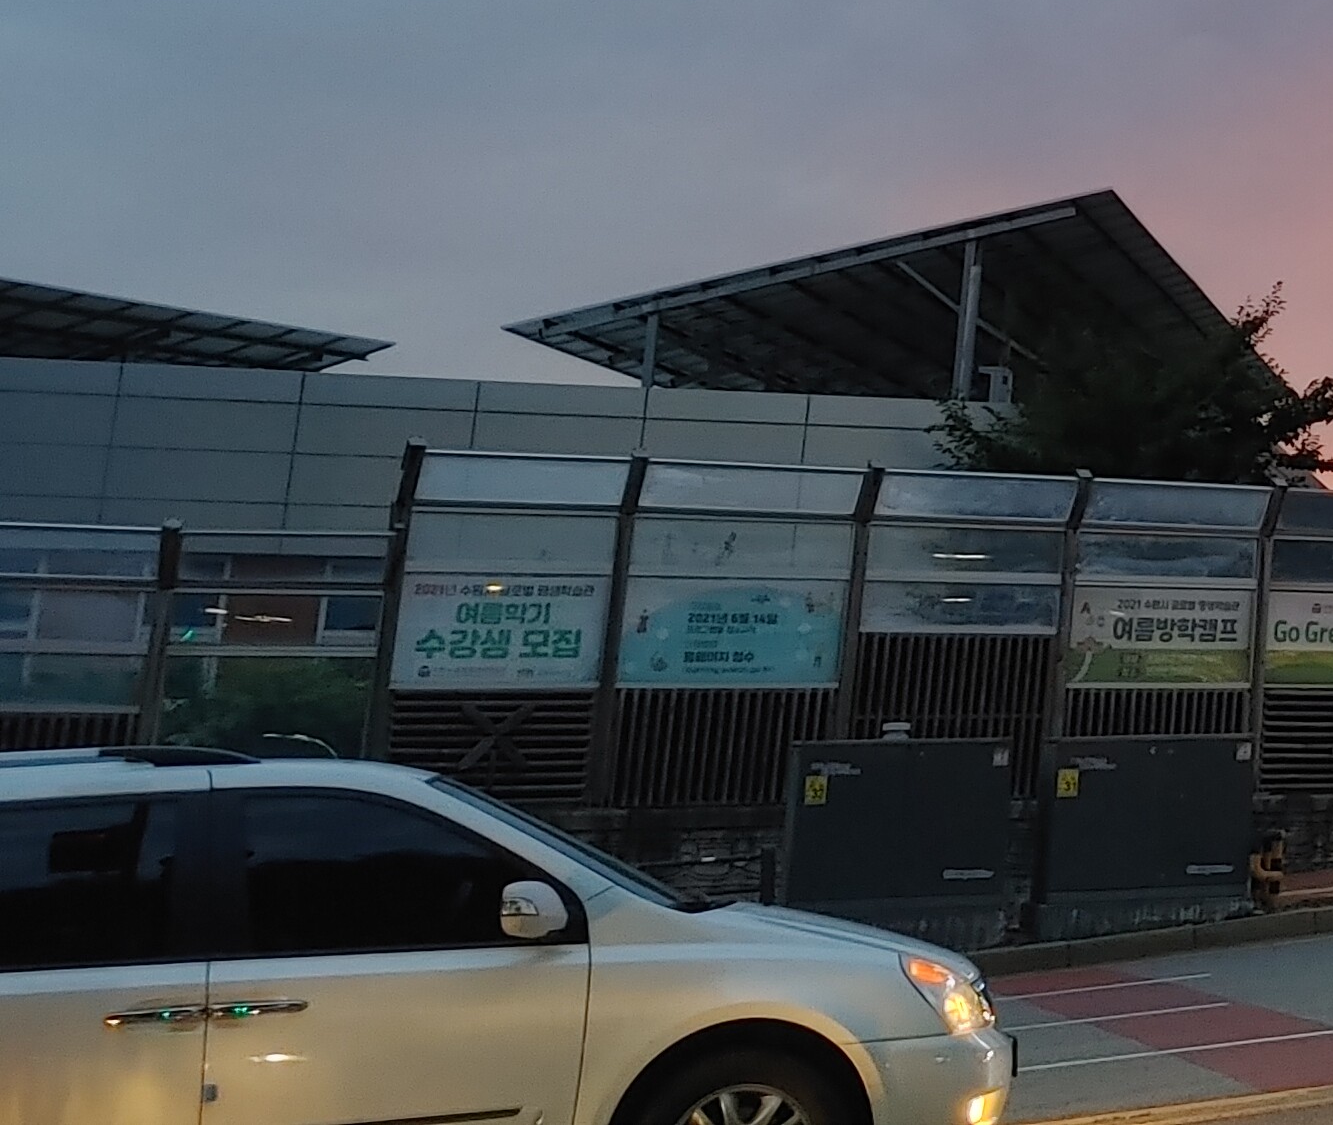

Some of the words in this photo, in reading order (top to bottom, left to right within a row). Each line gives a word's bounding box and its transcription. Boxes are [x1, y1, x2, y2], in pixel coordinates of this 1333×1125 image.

[455, 602, 552, 625] 여름학기
[1117, 598, 1142, 610] 2021
[687, 613, 728, 625] 2021년
[1112, 617, 1238, 643] 여름방학캠프
[1273, 619, 1300, 643] Go
[414, 628, 512, 659] 수강생
[519, 628, 582, 659] 모집
